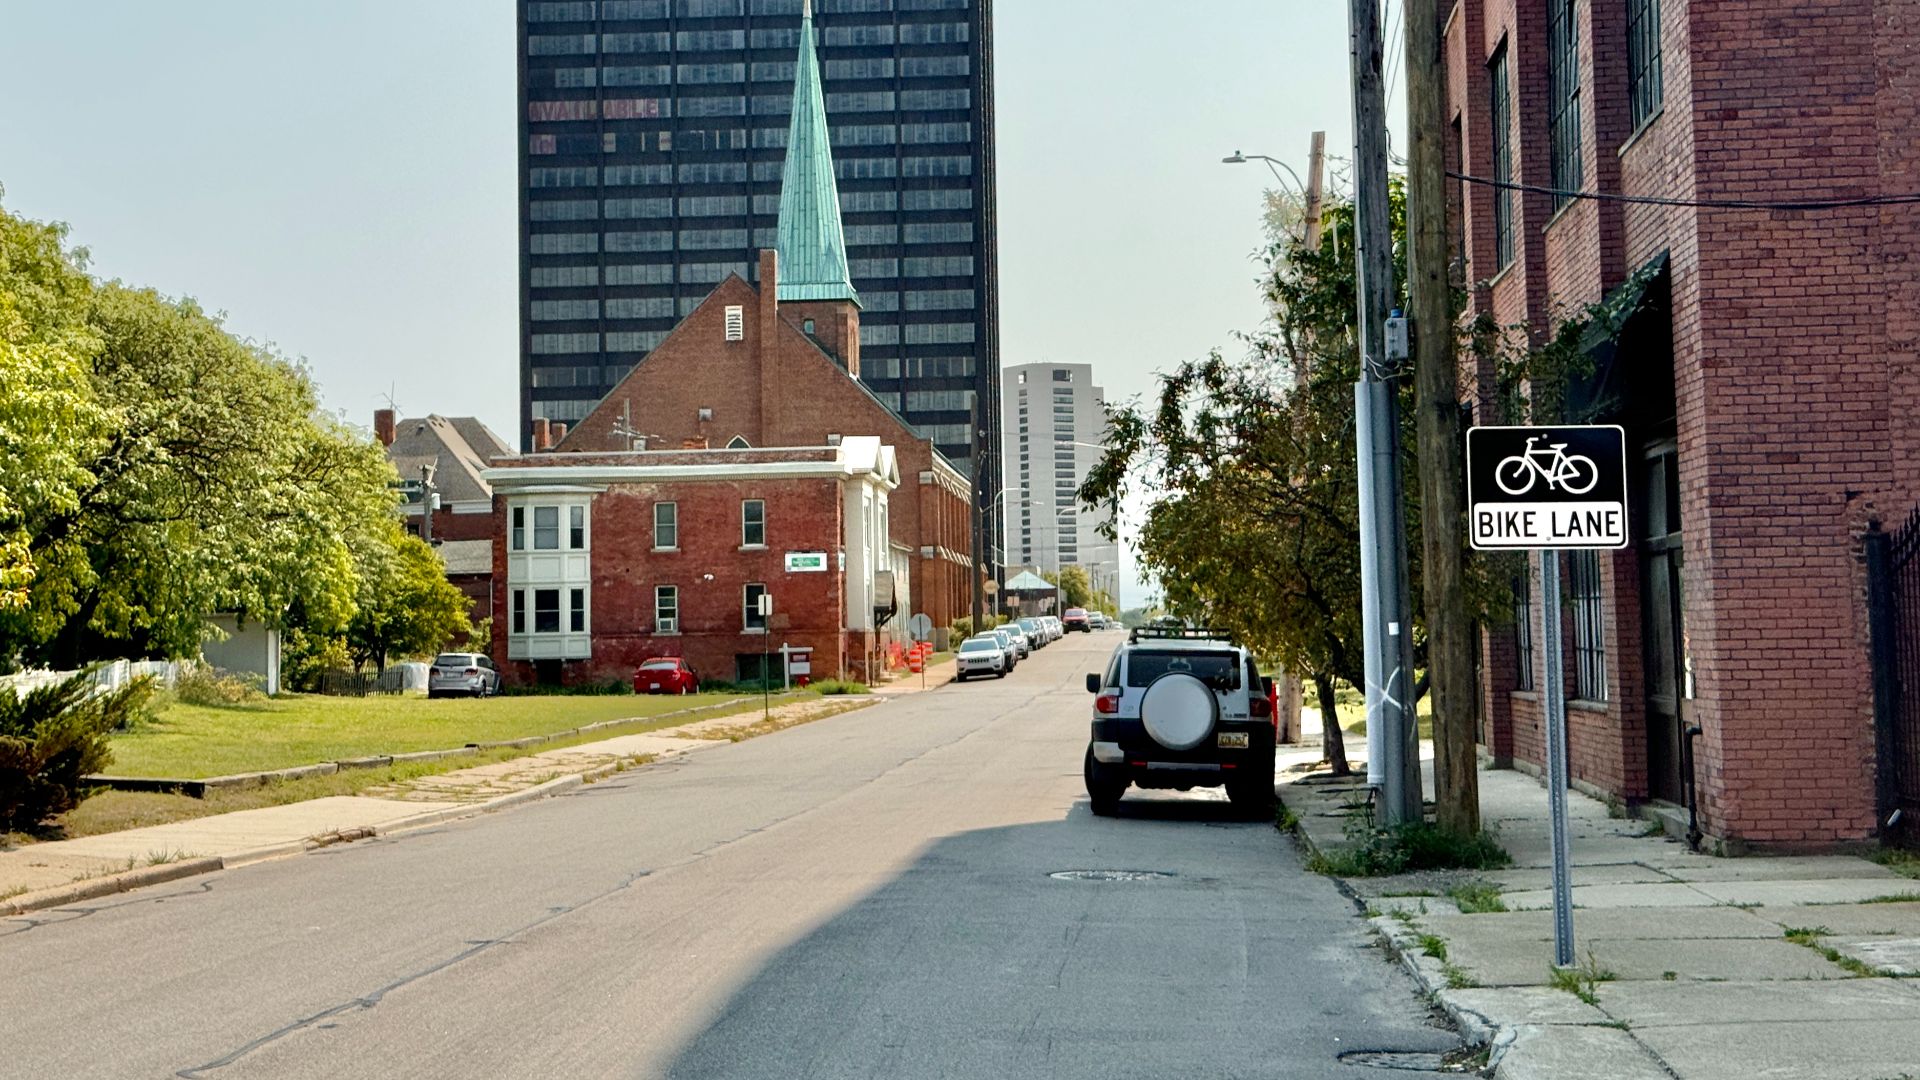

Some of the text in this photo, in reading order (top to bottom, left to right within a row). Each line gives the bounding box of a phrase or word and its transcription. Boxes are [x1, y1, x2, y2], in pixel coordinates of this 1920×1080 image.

[529, 98, 658, 121] AVAILABLE
[1478, 510, 1620, 538] BIKE LANE
